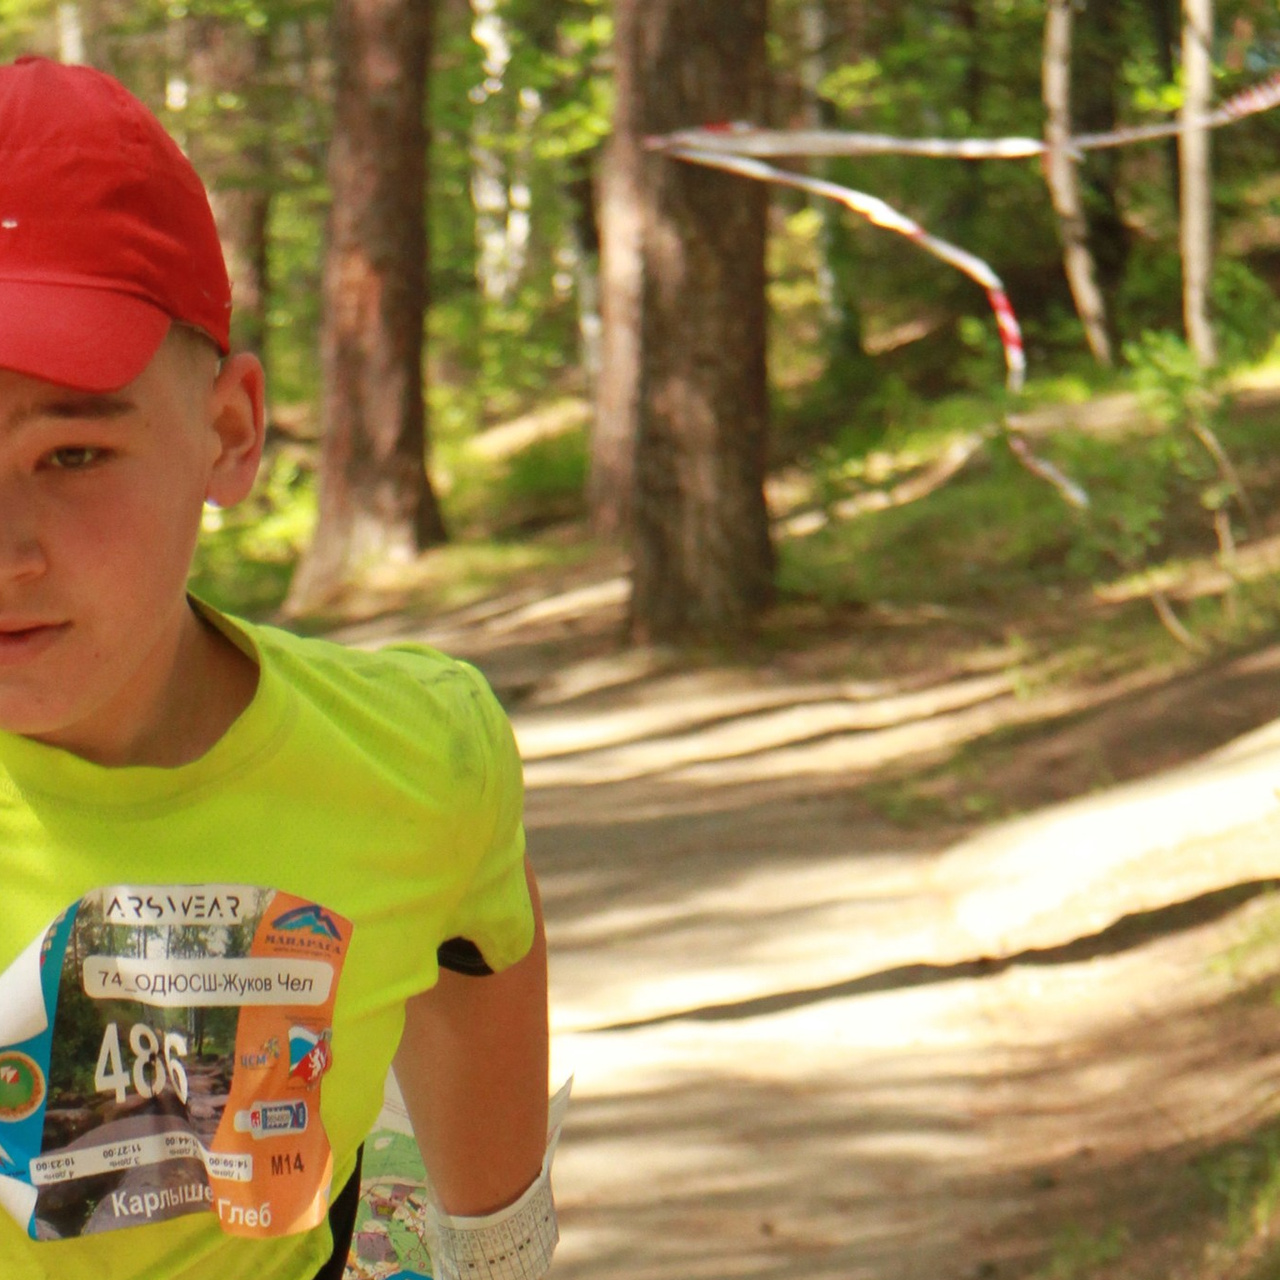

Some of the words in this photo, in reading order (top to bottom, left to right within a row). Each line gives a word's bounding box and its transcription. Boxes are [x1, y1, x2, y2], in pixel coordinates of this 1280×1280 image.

[106, 895, 241, 918] ARSWEAR
[277, 973, 314, 992] Чел
[94, 1022, 188, 1105] 486
[35, 1157, 75, 1172] 10:23:00
[217, 1198, 272, 1228] Глеб
